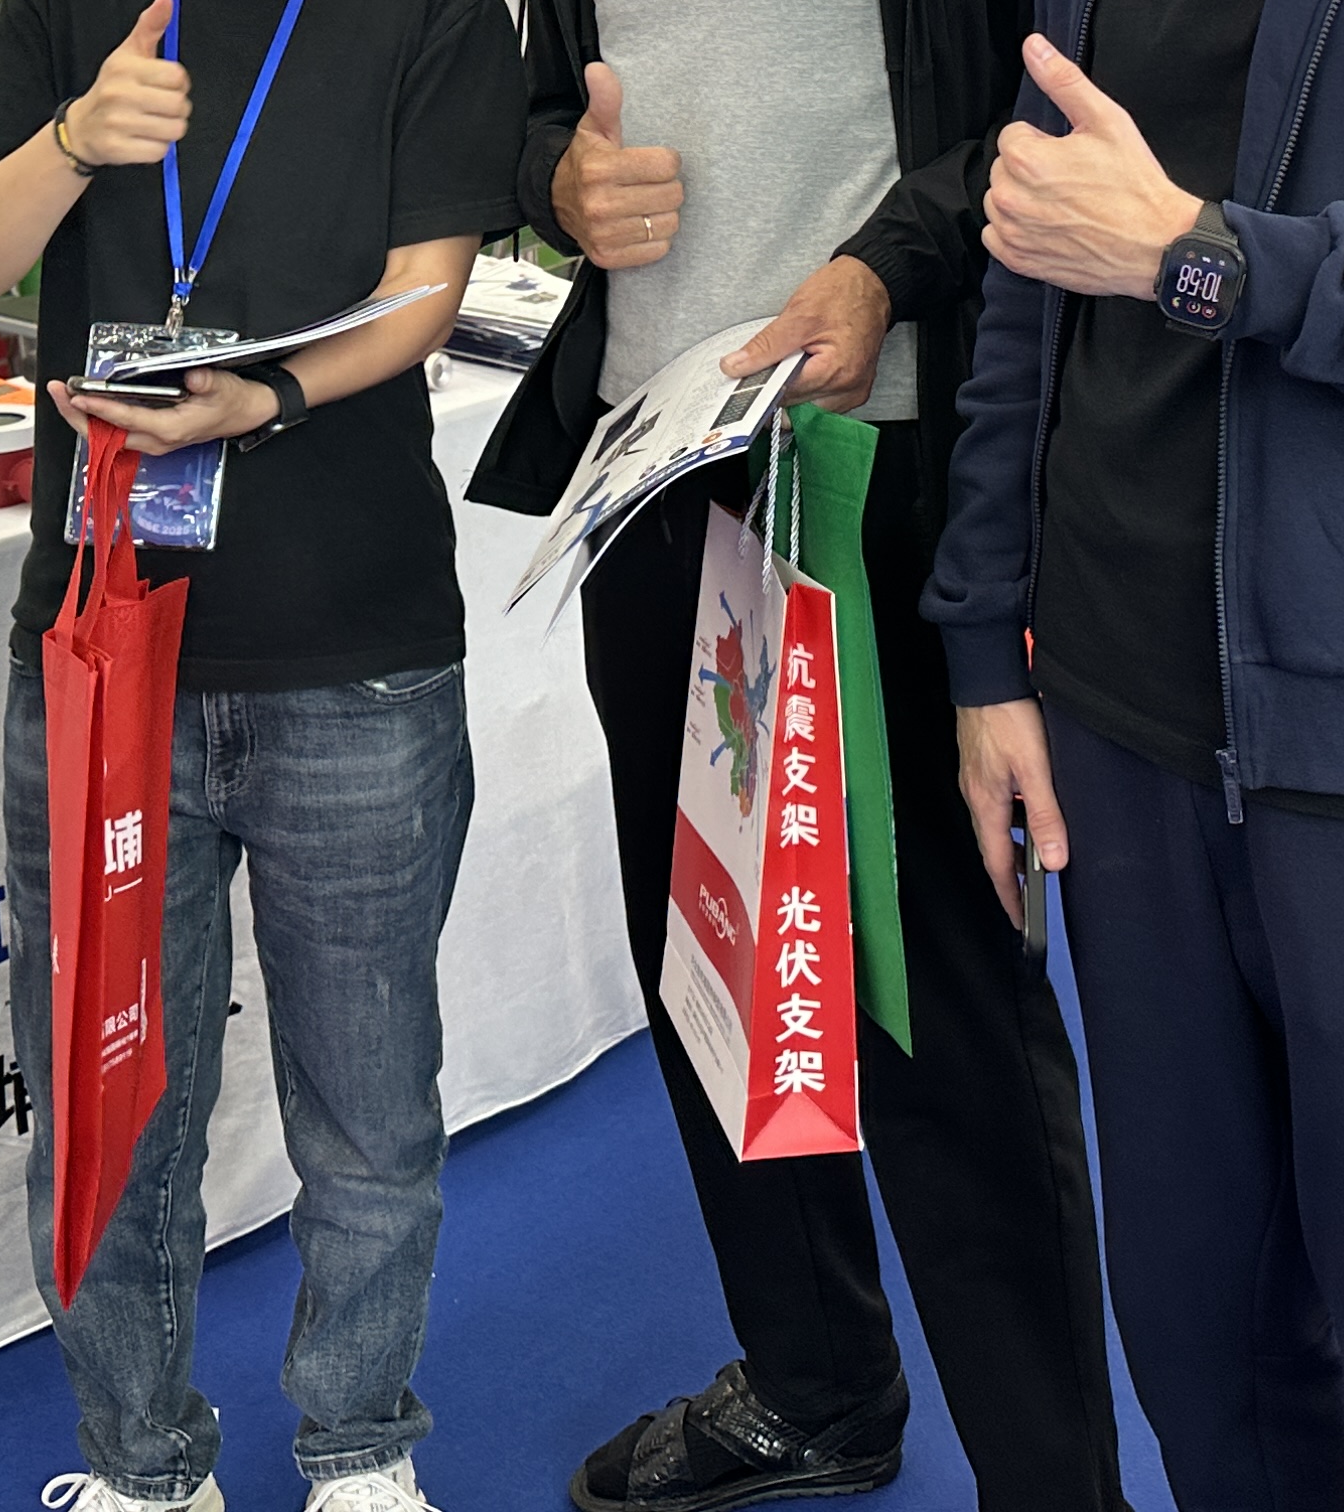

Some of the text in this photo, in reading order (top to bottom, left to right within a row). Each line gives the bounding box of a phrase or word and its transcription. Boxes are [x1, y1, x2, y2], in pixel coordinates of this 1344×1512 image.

[1175, 264, 1222, 303] 10:58
[783, 643, 821, 849] 抗震支架
[101, 1002, 139, 1041] 限公司
[773, 885, 827, 1095] 光伏支架
